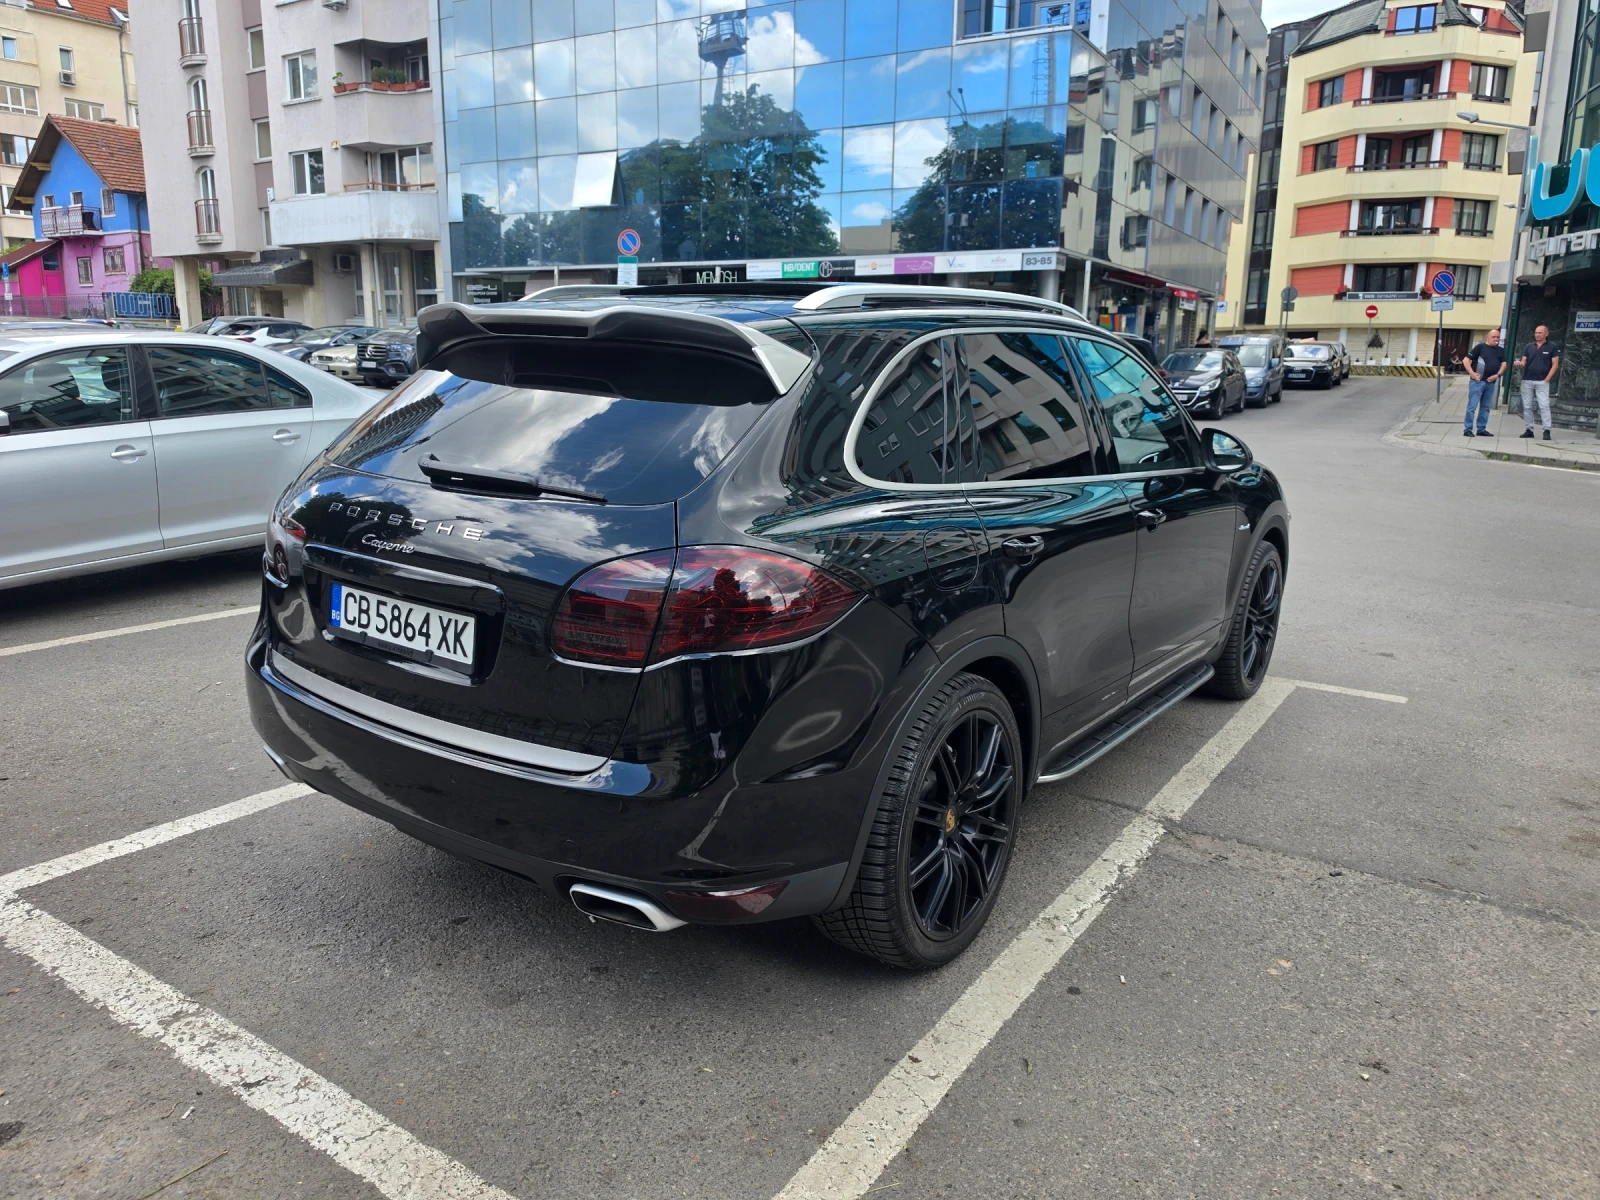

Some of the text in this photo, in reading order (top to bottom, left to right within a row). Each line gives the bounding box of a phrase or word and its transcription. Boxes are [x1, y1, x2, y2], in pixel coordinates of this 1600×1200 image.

[1025, 256, 1053, 266] 83-85
[328, 501, 484, 541] PORSCHE
[361, 533, 415, 553] Cayenne
[331, 609, 341, 621] BG
